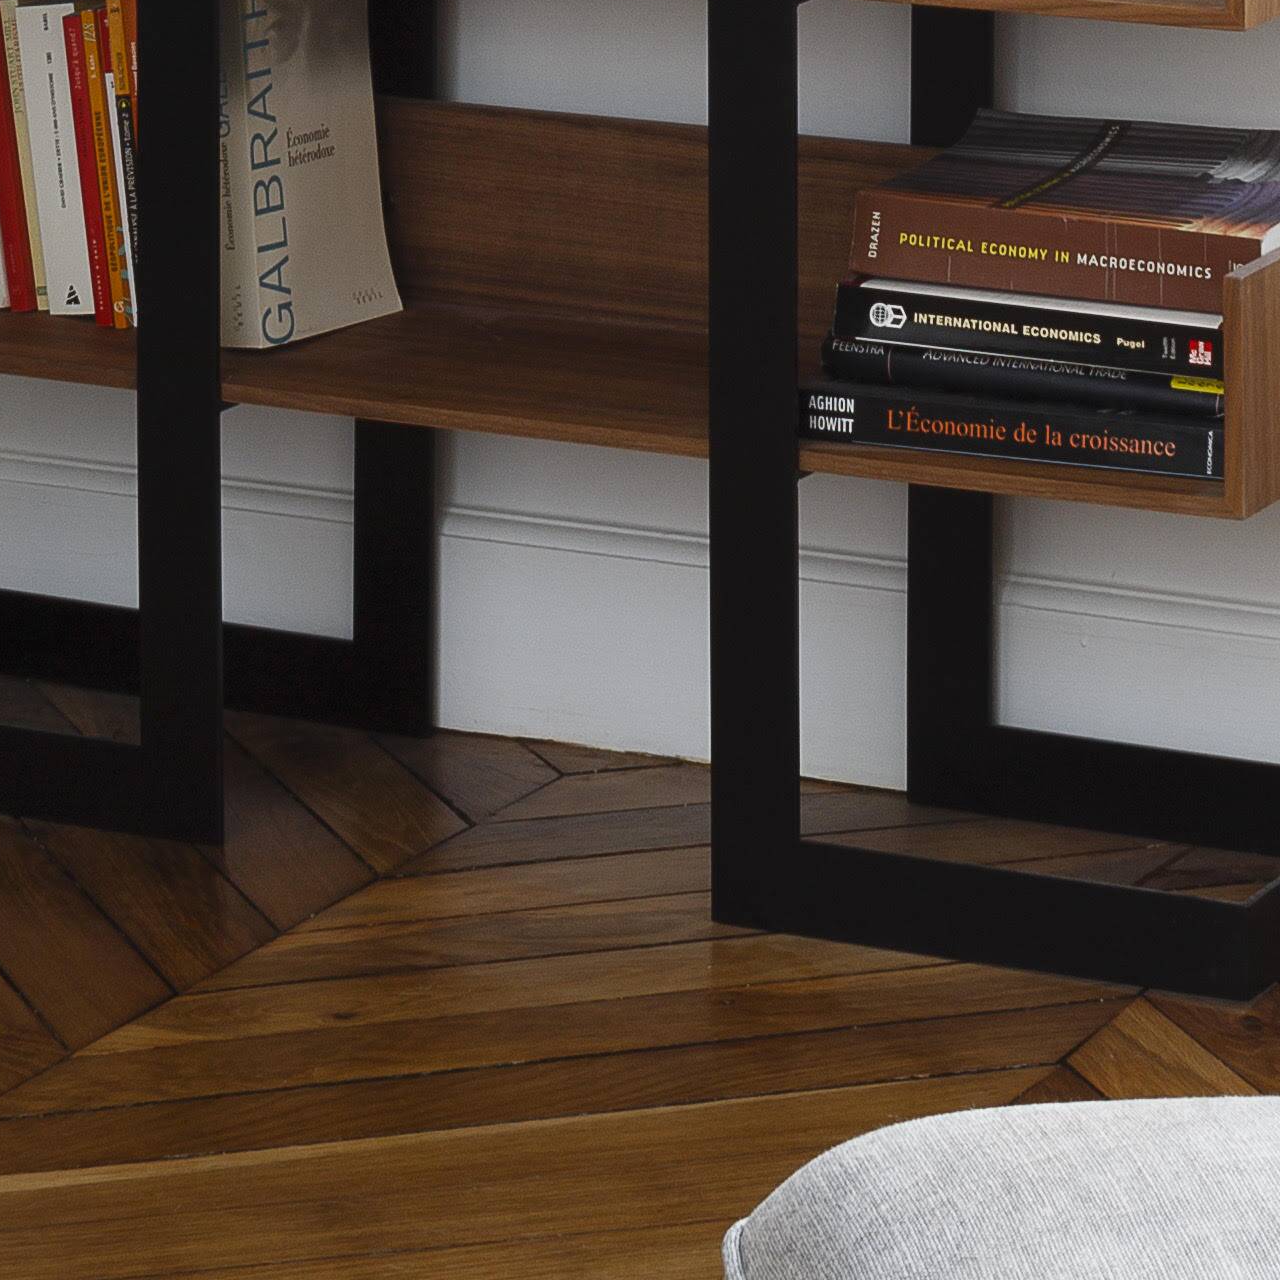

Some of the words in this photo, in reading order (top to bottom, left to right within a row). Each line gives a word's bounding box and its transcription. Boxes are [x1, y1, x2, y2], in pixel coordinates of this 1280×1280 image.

[286, 124, 330, 149] Économie
[288, 143, 335, 167] hétérodoxe
[868, 210, 881, 259] DRAZEN
[899, 232, 974, 253] POLITICAL
[981, 242, 1048, 261] ECONOMY
[1054, 250, 1070, 264] IN
[1076, 253, 1212, 280] MACROECONOMICS
[914, 312, 1018, 335] INTERNATIONAL
[1022, 325, 1102, 345] ECONOMICS
[832, 339, 885, 356] FEENSTRA
[992, 358, 1085, 376] INTERNATIONAL
[809, 395, 855, 413] AGHION
[809, 416, 855, 434] HOWITT
[887, 406, 1007, 440] L'Économie
[1013, 421, 1038, 444] de
[1045, 423, 1062, 447] la
[1070, 430, 1176, 457] croissance
